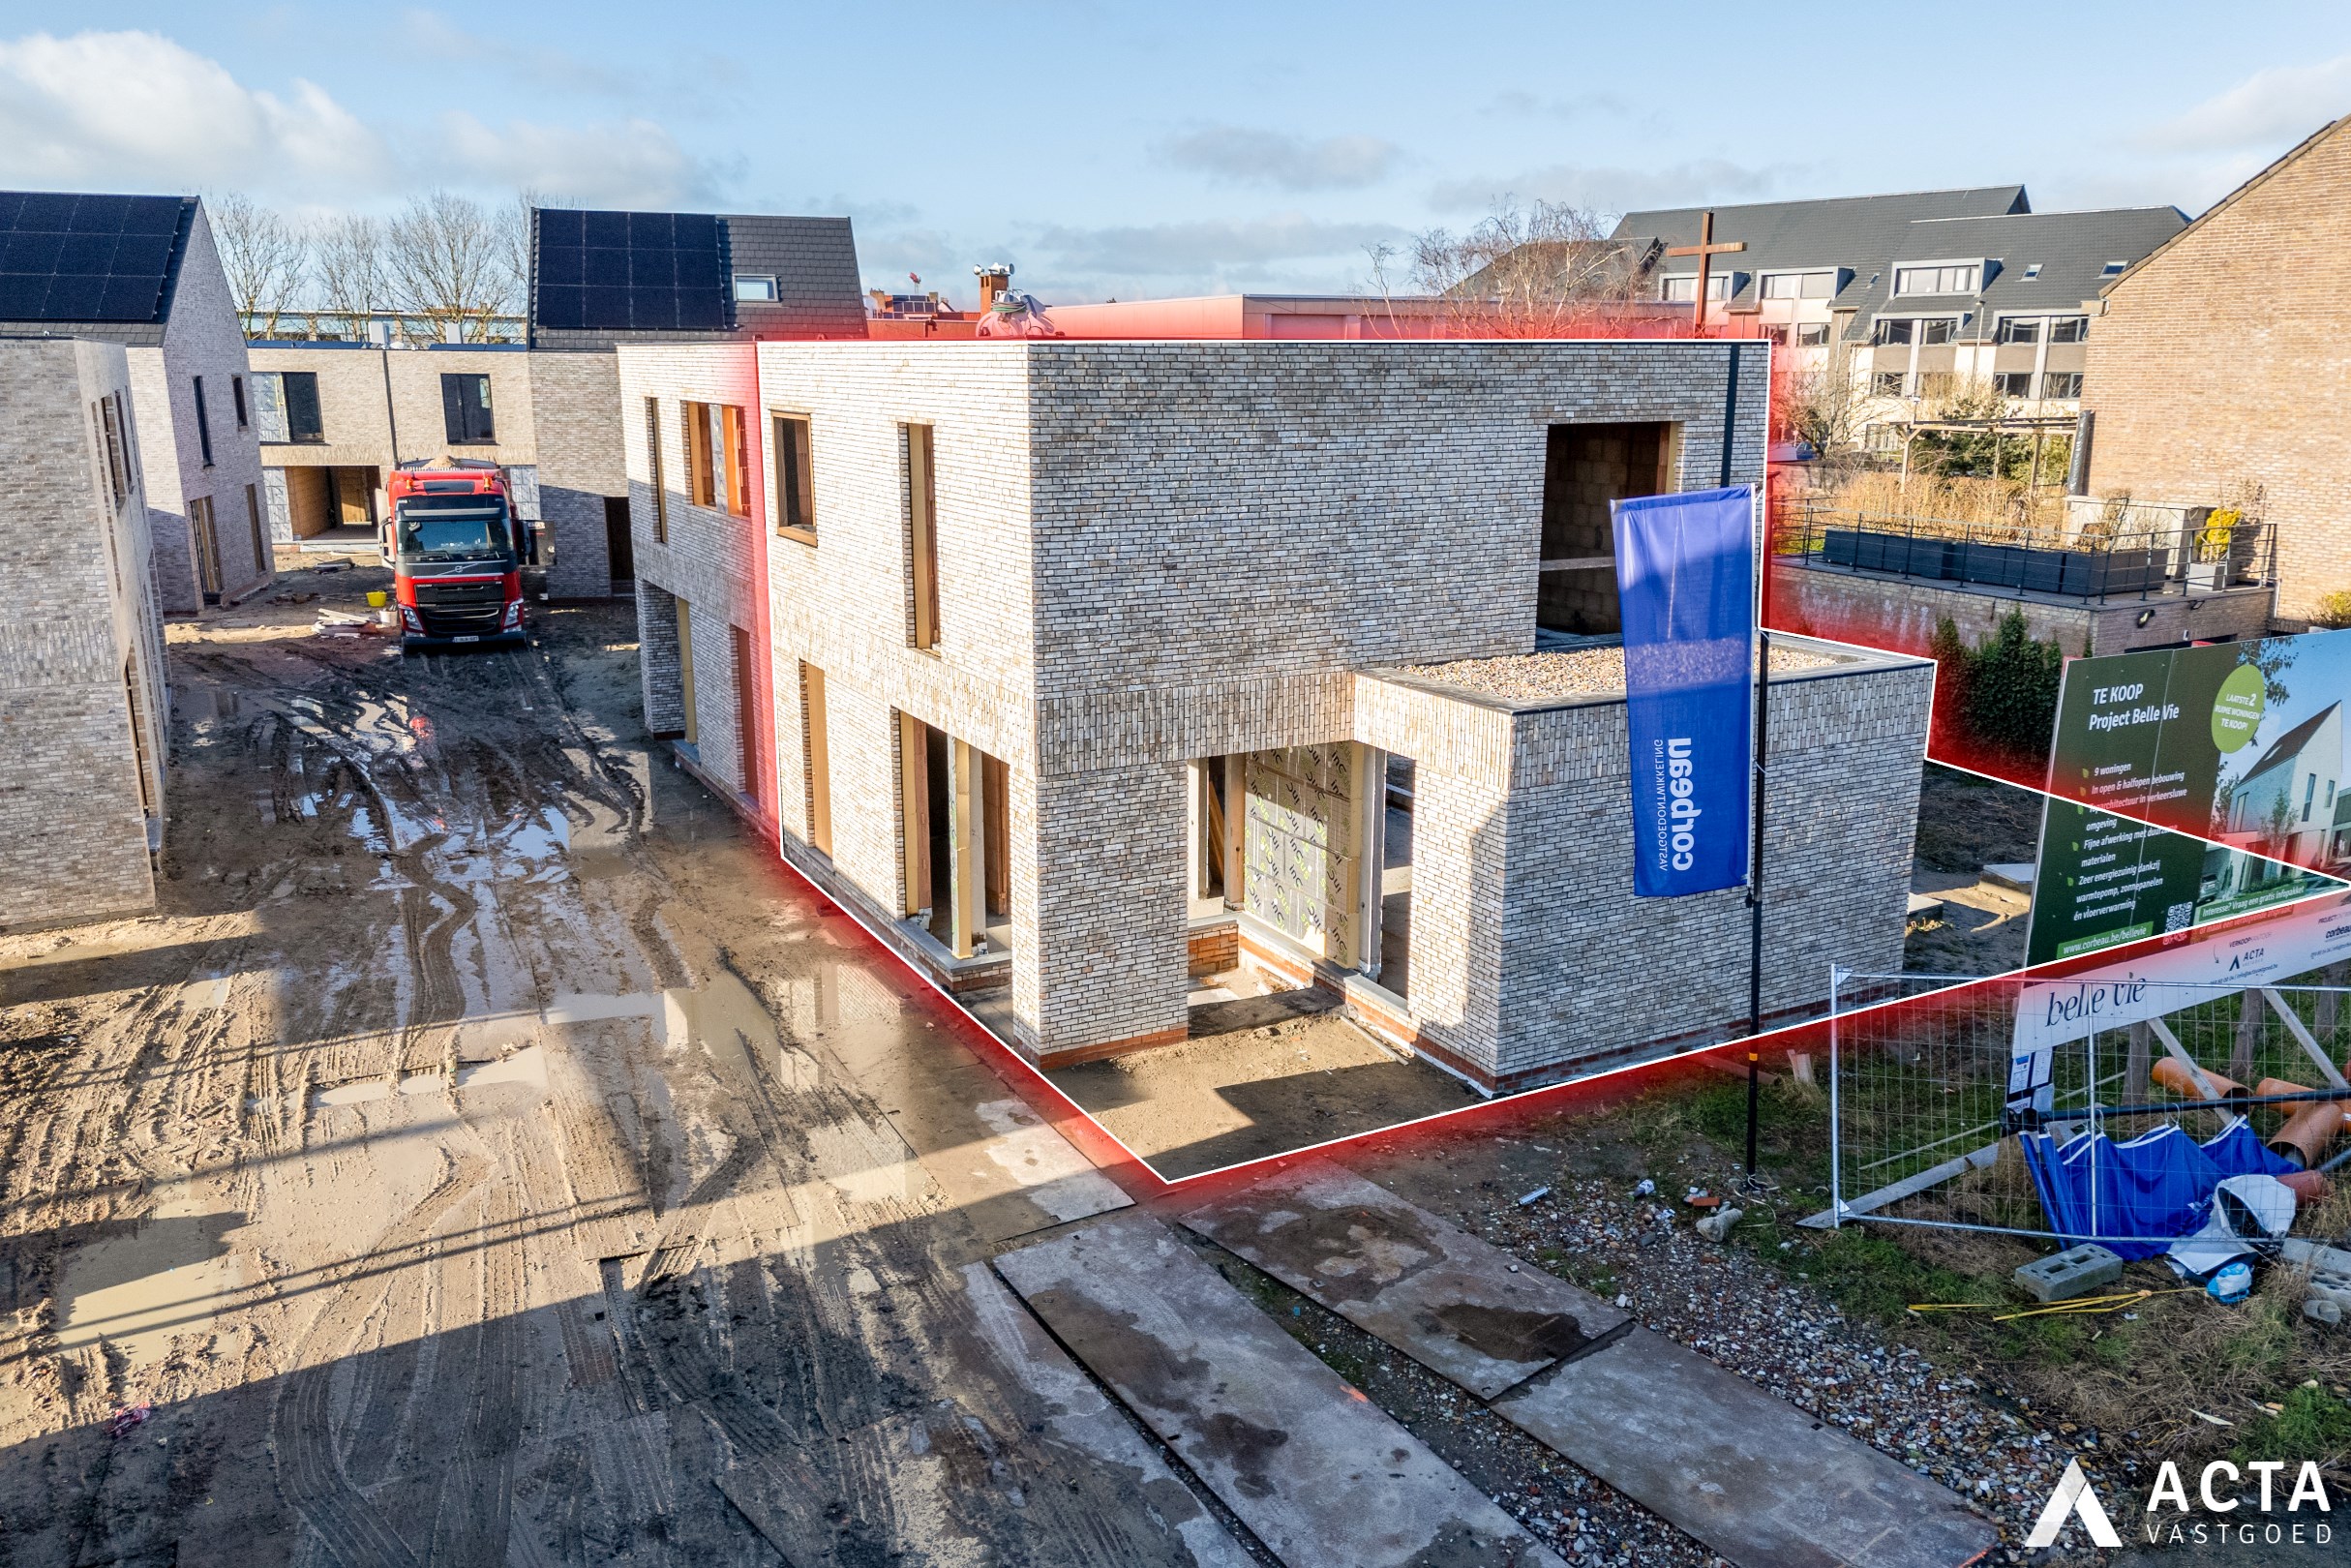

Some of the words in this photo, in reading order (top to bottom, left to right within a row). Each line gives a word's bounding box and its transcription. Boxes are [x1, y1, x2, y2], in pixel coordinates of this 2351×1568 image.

[2093, 687, 2108, 705] TE
[2110, 683, 2144, 703] KOOP
[2249, 693, 2257, 707] 2
[2089, 709, 2130, 732] Project
[2131, 705, 2160, 724] Belle
[2162, 703, 2180, 720] Vie
[2095, 767, 2099, 776] 9
[2100, 763, 2131, 774] woningen
[2091, 786, 2098, 795] In
[2099, 783, 2116, 795] open
[2116, 780, 2122, 790] &
[2123, 776, 2151, 789] halfopen
[2151, 771, 2185, 785] bebouwing
[2139, 794, 2146, 802] in
[2147, 788, 2187, 801] verkeersluwe
[2086, 818, 2118, 831] omgeving
[2083, 839, 2100, 851] Fijne
[2100, 832, 2133, 845] afwerking
[2133, 829, 2147, 838] met
[2081, 853, 2116, 867] materialen
[2078, 875, 2095, 886] Zeer
[2095, 865, 2137, 881] energiezuinig
[2138, 859, 2161, 873] dankzij
[2076, 887, 2120, 903] warmtepomp,
[2120, 877, 2163, 893] zonnepanelen
[2073, 911, 2082, 920] én
[2083, 898, 2136, 919] vloerverwarming
[2203, 903, 2232, 918] Interesse?
[2232, 900, 2247, 910] Vraag
[2259, 892, 2275, 905] gratis
[2064, 926, 2147, 954] www.corbeau.be/bellevie
[2244, 948, 2264, 962] ACTA
